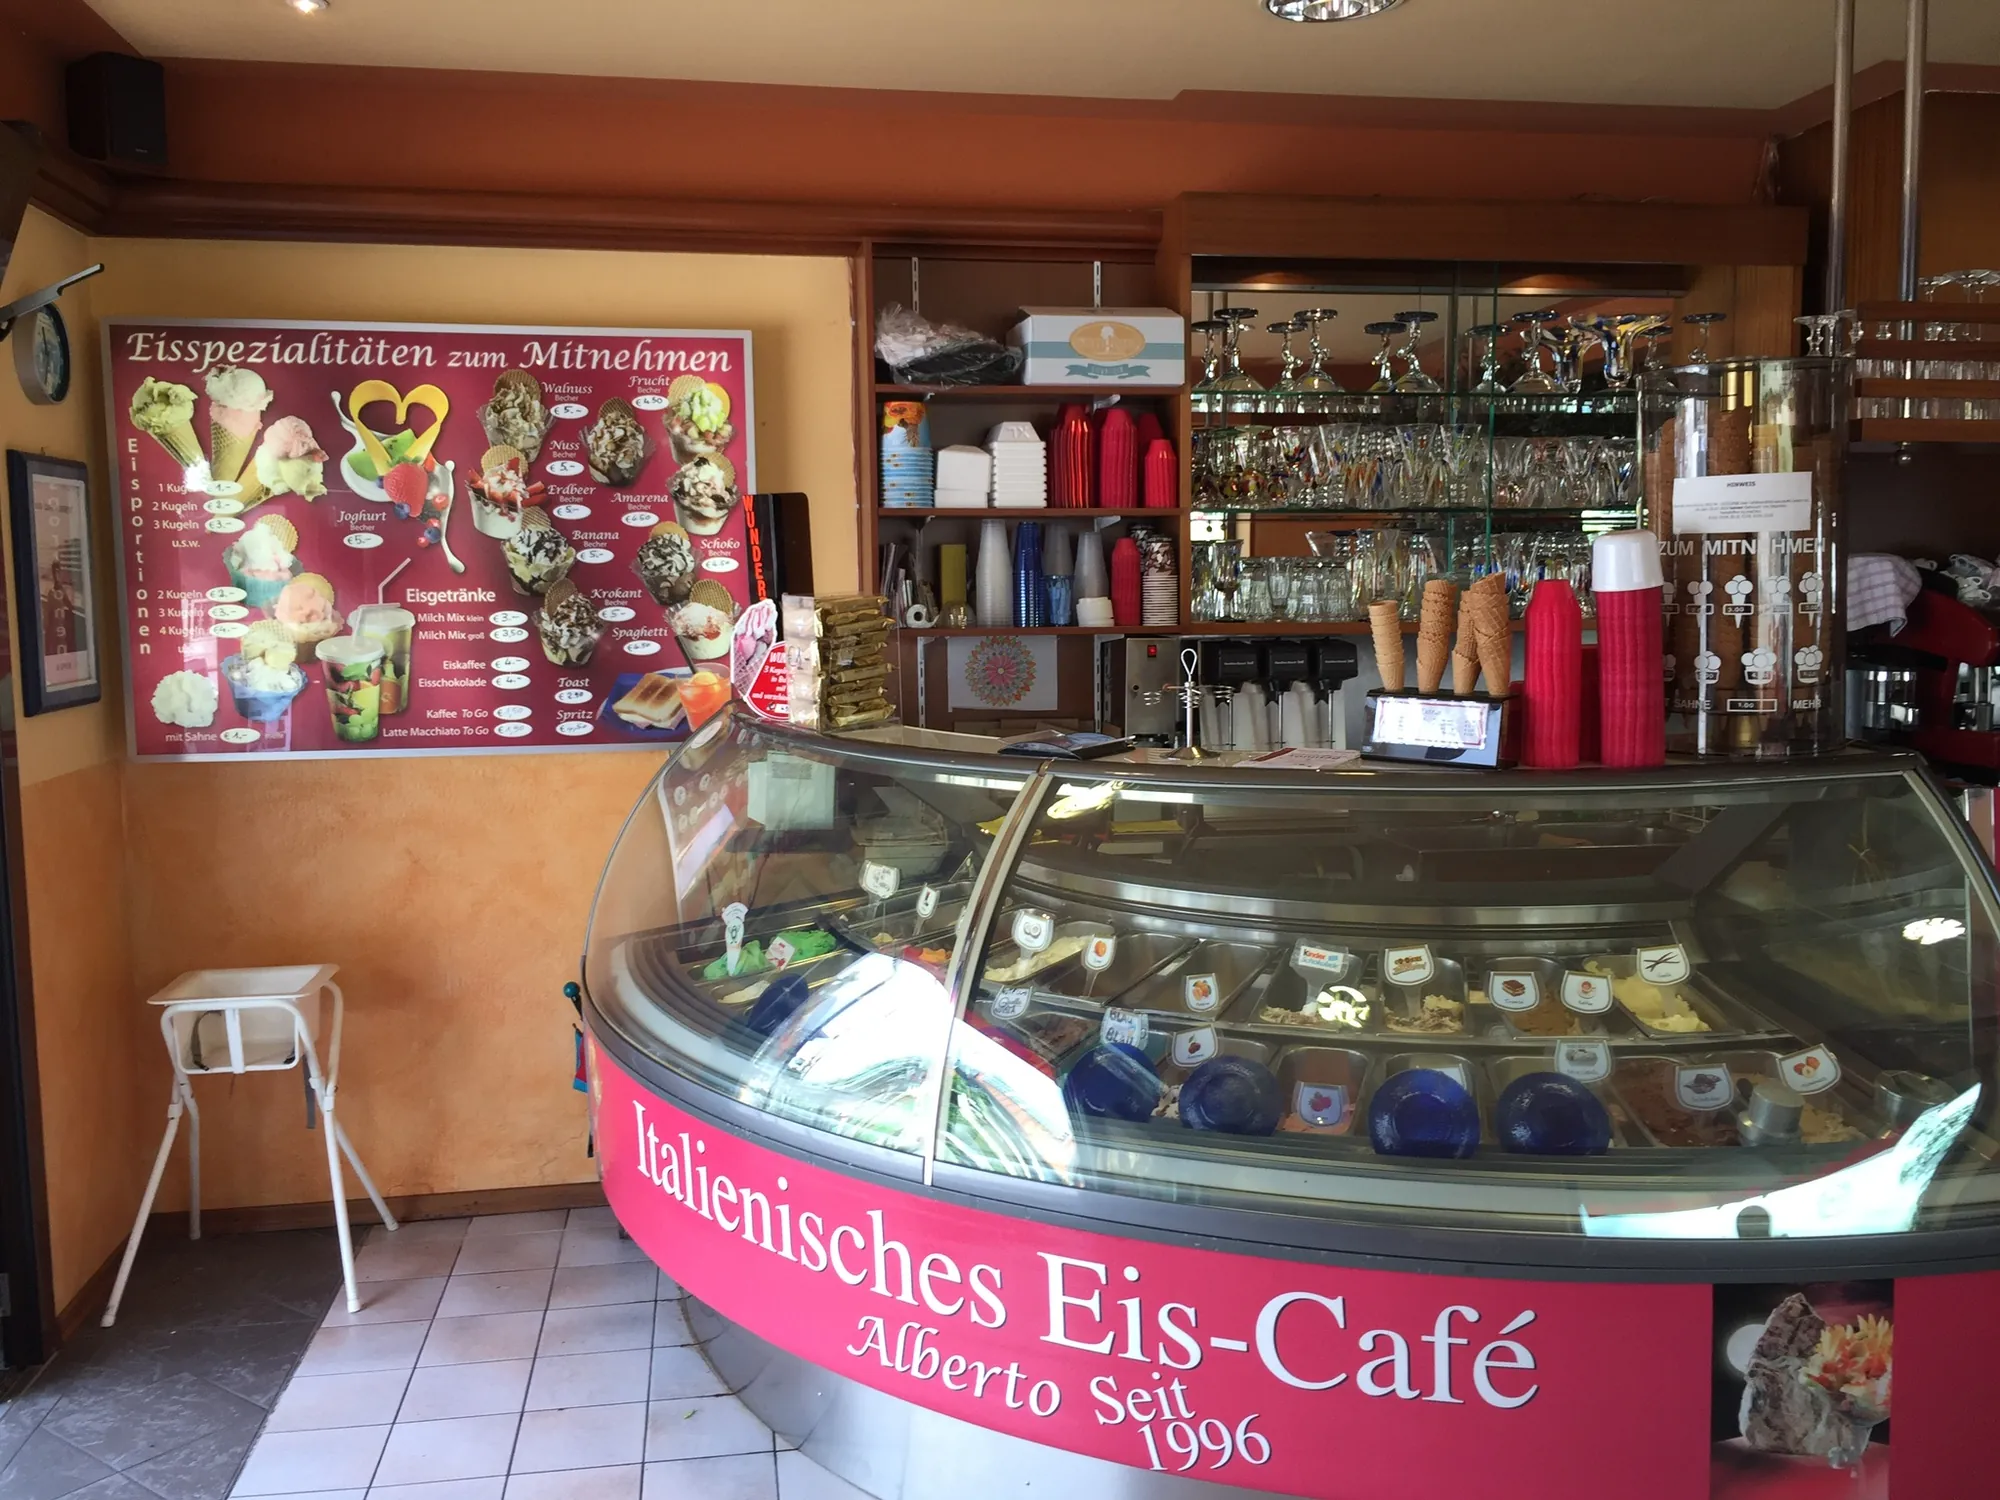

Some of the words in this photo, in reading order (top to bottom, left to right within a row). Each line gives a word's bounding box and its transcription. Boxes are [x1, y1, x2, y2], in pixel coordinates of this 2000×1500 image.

[126, 331, 437, 373] Eisspezialitäten
[447, 348, 509, 369] zum
[518, 339, 733, 372] Mitnehmen
[627, 374, 670, 388] Frucht
[542, 381, 593, 394] Walnuss
[637, 386, 661, 394] Becher
[554, 394, 579, 402] Becher
[549, 440, 580, 451] Nuss
[552, 450, 577, 458] Becher
[547, 483, 597, 495] Erdbeer
[559, 495, 584, 503] Becher
[610, 492, 669, 503] Amarena
[152, 501, 160, 511] 2
[161, 501, 198, 513] Kugeln
[627, 503, 651, 511] Becher
[337, 509, 387, 525] Joghurt
[153, 520, 160, 529] 3
[162, 520, 199, 532] Kugeln
[572, 529, 620, 540] Banana
[171, 540, 201, 548] u.s.w.
[583, 540, 607, 548] Becher
[700, 537, 741, 549] Schoko
[1658, 540, 1694, 556] ZUM
[708, 549, 732, 557] Becher
[157, 590, 164, 599] 2
[166, 589, 203, 600] Kugeln
[406, 587, 497, 606] Eisgetränke
[590, 587, 643, 599] Krokant
[604, 598, 628, 606] Becher
[158, 608, 166, 617] 3
[417, 612, 445, 623] Milch
[446, 612, 466, 623] Mix
[466, 614, 485, 623] klein
[159, 626, 166, 635] 4
[168, 626, 205, 637] Kugeln
[418, 630, 446, 640] Milch
[447, 630, 467, 640] Mix
[467, 632, 486, 641] groß
[612, 627, 669, 641] Spaghetti
[442, 659, 487, 670] Eiskaffee
[418, 677, 487, 688] Eisschokolade
[557, 676, 590, 688] Toast
[426, 709, 458, 719] Kaffee
[461, 708, 473, 718] To
[474, 708, 489, 718] Go
[556, 709, 593, 722] Spritz
[165, 733, 183, 742] mit
[184, 731, 217, 741] Sahne
[382, 727, 409, 737] Latte
[409, 726, 461, 737] Macchiato
[462, 726, 474, 736] To
[475, 726, 490, 735] Go
[631, 1100, 1007, 1329] Italienisches
[1036, 1251, 1539, 1410] Eis-Café
[846, 1315, 1062, 1418] Alberto
[1088, 1371, 1196, 1426] Seit
[1137, 1412, 1273, 1472] 1996
